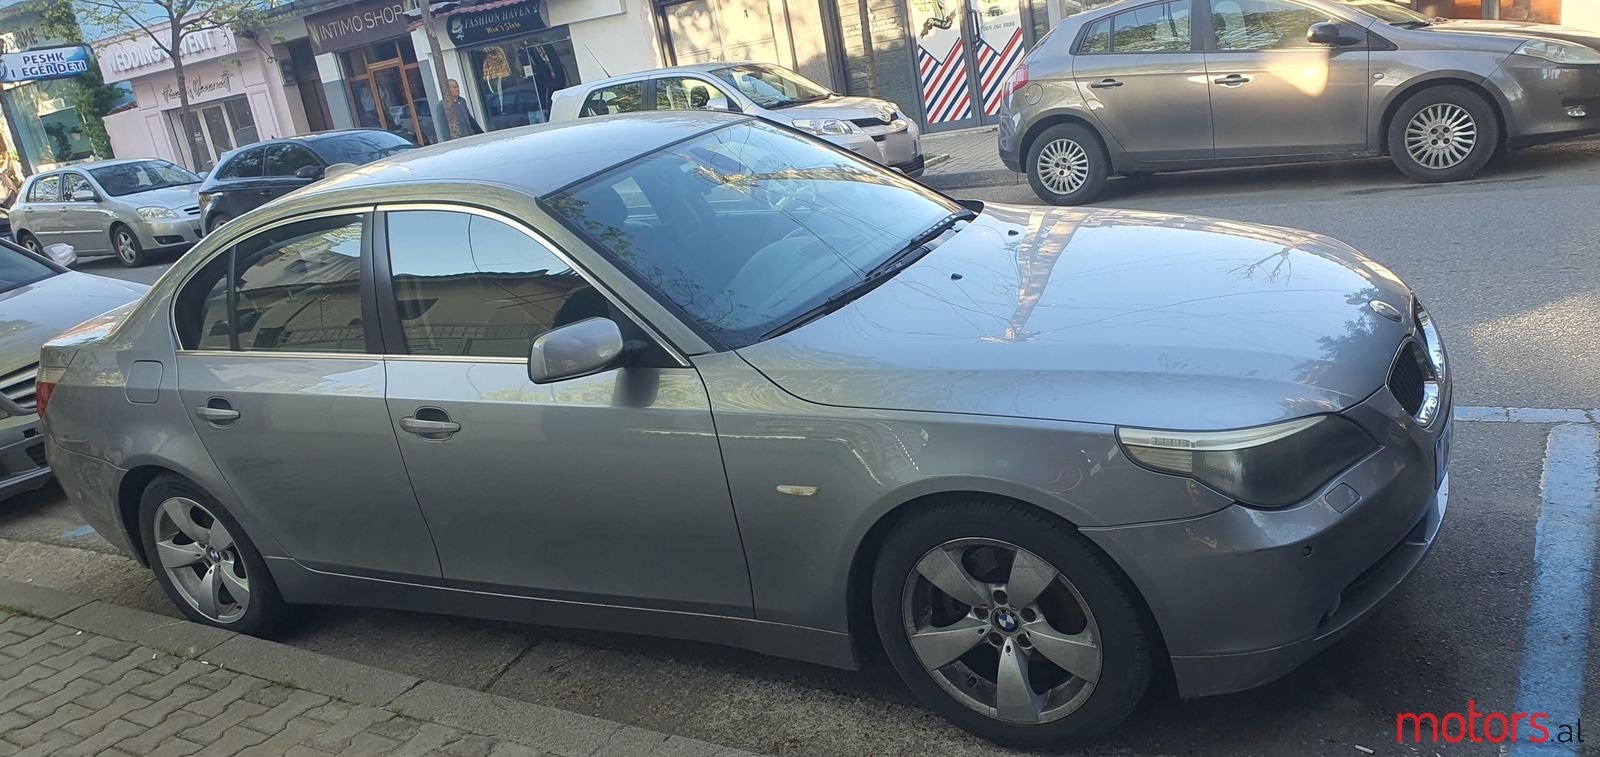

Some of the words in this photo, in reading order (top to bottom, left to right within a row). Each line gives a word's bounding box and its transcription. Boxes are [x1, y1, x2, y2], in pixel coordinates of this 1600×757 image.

[319, 16, 363, 40] INTIMO
[364, 4, 403, 29] SHOP
[464, 12, 500, 29] FASHION
[502, 5, 531, 20] HAVEN
[22, 52, 65, 65] PESHK
[11, 69, 16, 78] I
[22, 63, 57, 77] EGËR
[57, 61, 86, 74] DETI
